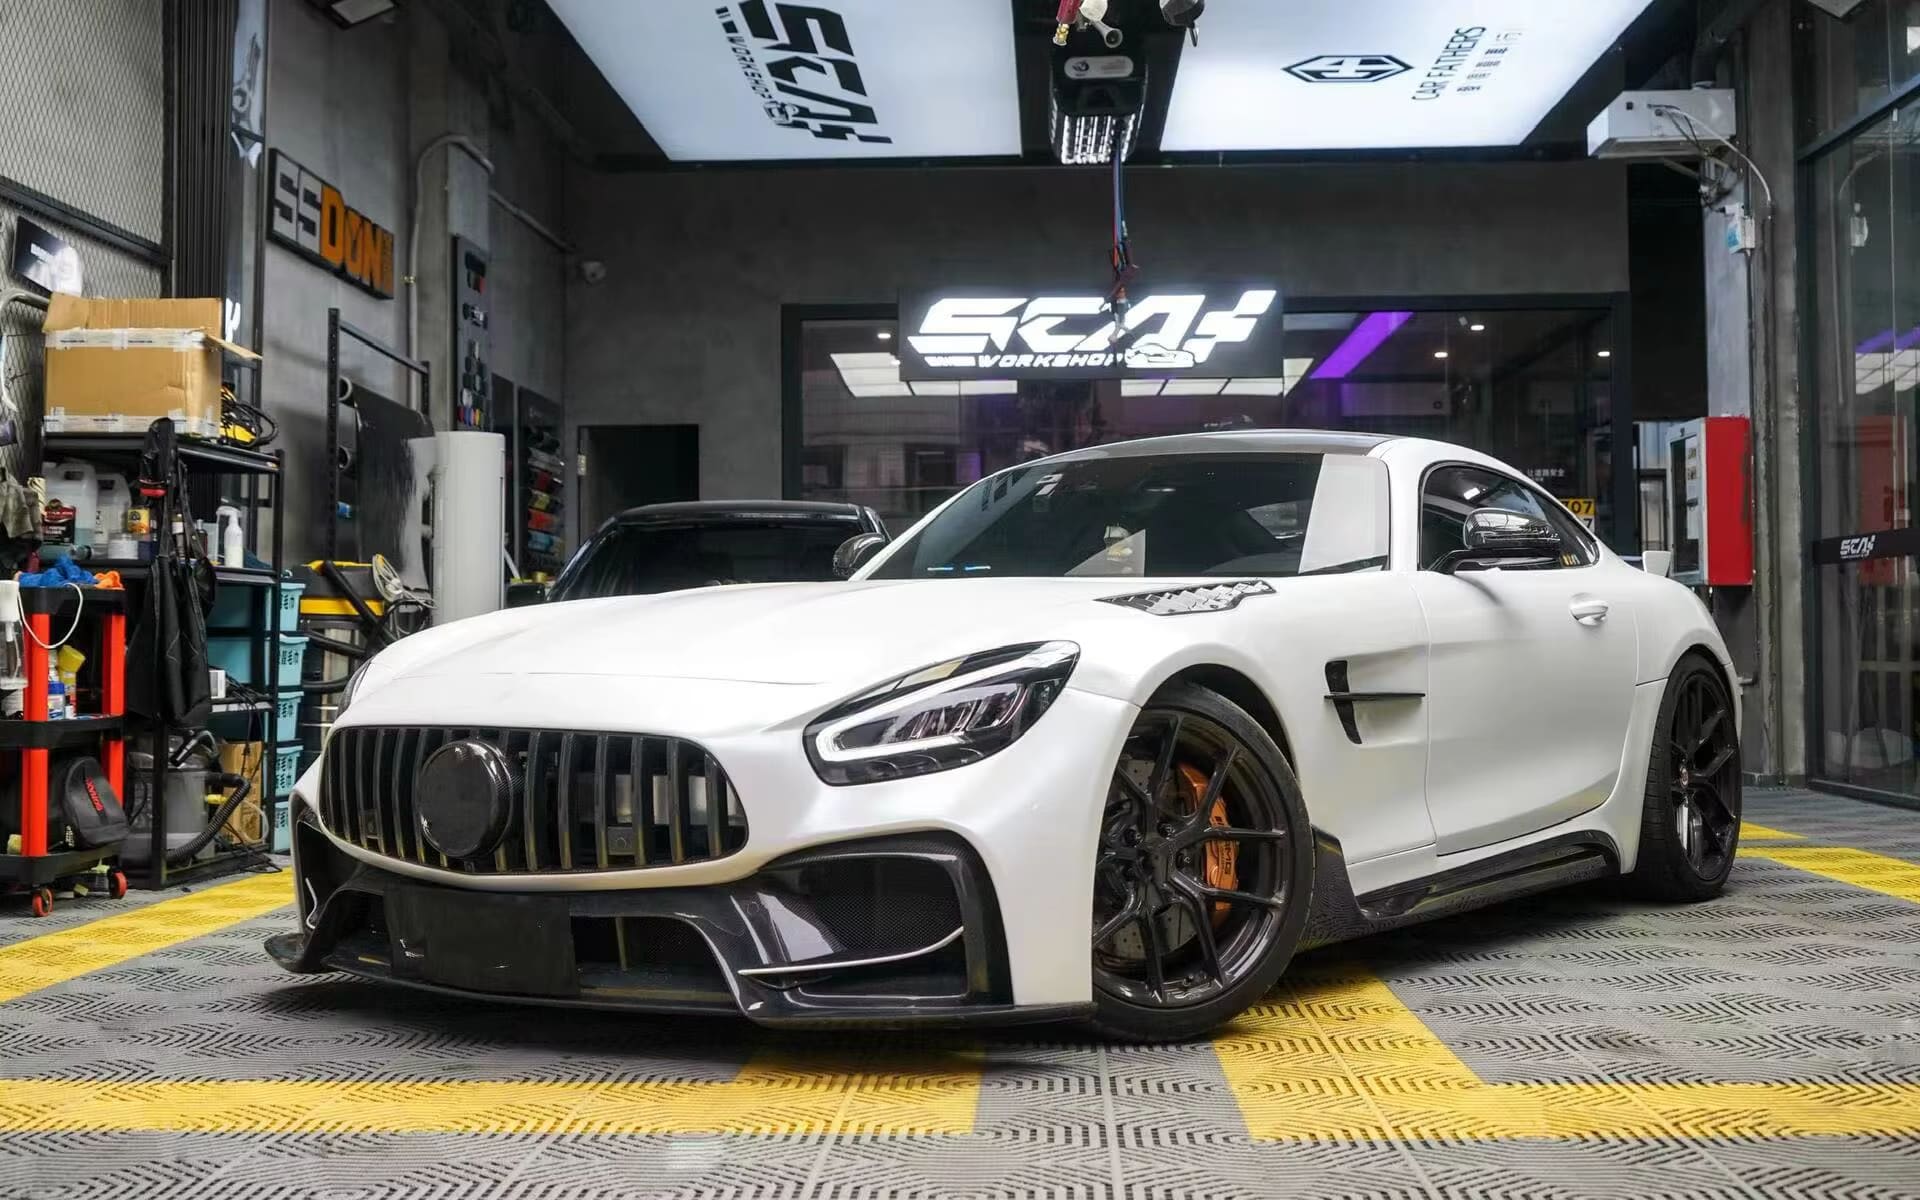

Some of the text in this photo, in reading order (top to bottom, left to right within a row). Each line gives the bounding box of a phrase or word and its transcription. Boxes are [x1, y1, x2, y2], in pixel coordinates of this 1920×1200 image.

[726, 36, 773, 101] WORKSHOP
[1426, 26, 1487, 78] FATHERS
[1411, 81, 1449, 100] CAR
[978, 352, 1123, 368] WORKSHOP
